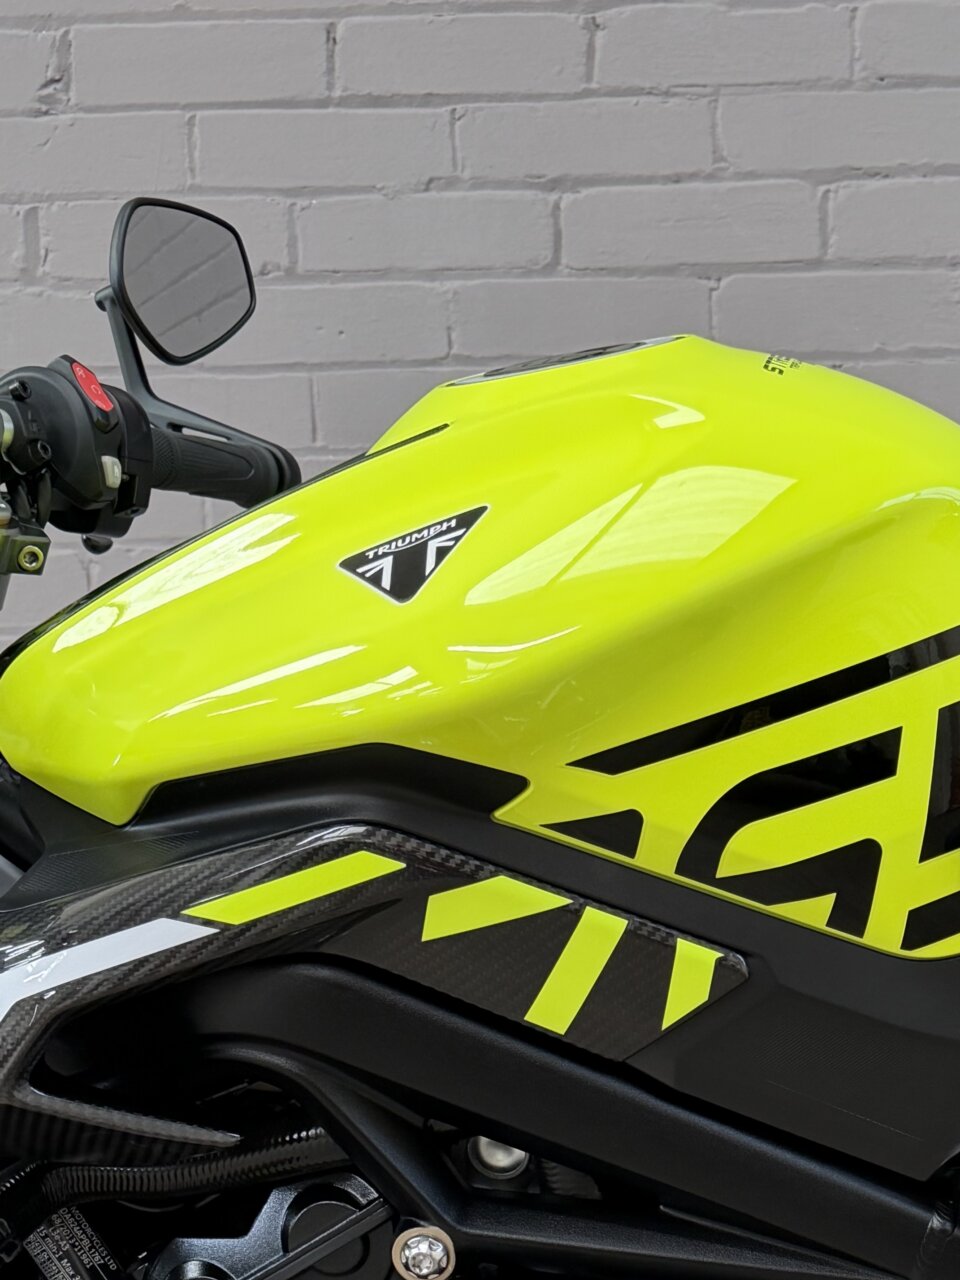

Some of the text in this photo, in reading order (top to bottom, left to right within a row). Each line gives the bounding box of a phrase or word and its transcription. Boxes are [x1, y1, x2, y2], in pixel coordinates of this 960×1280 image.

[365, 518, 457, 559] TRIUMPH
[60, 1259, 76, 1276] Max
[105, 1256, 117, 1271] LTD
